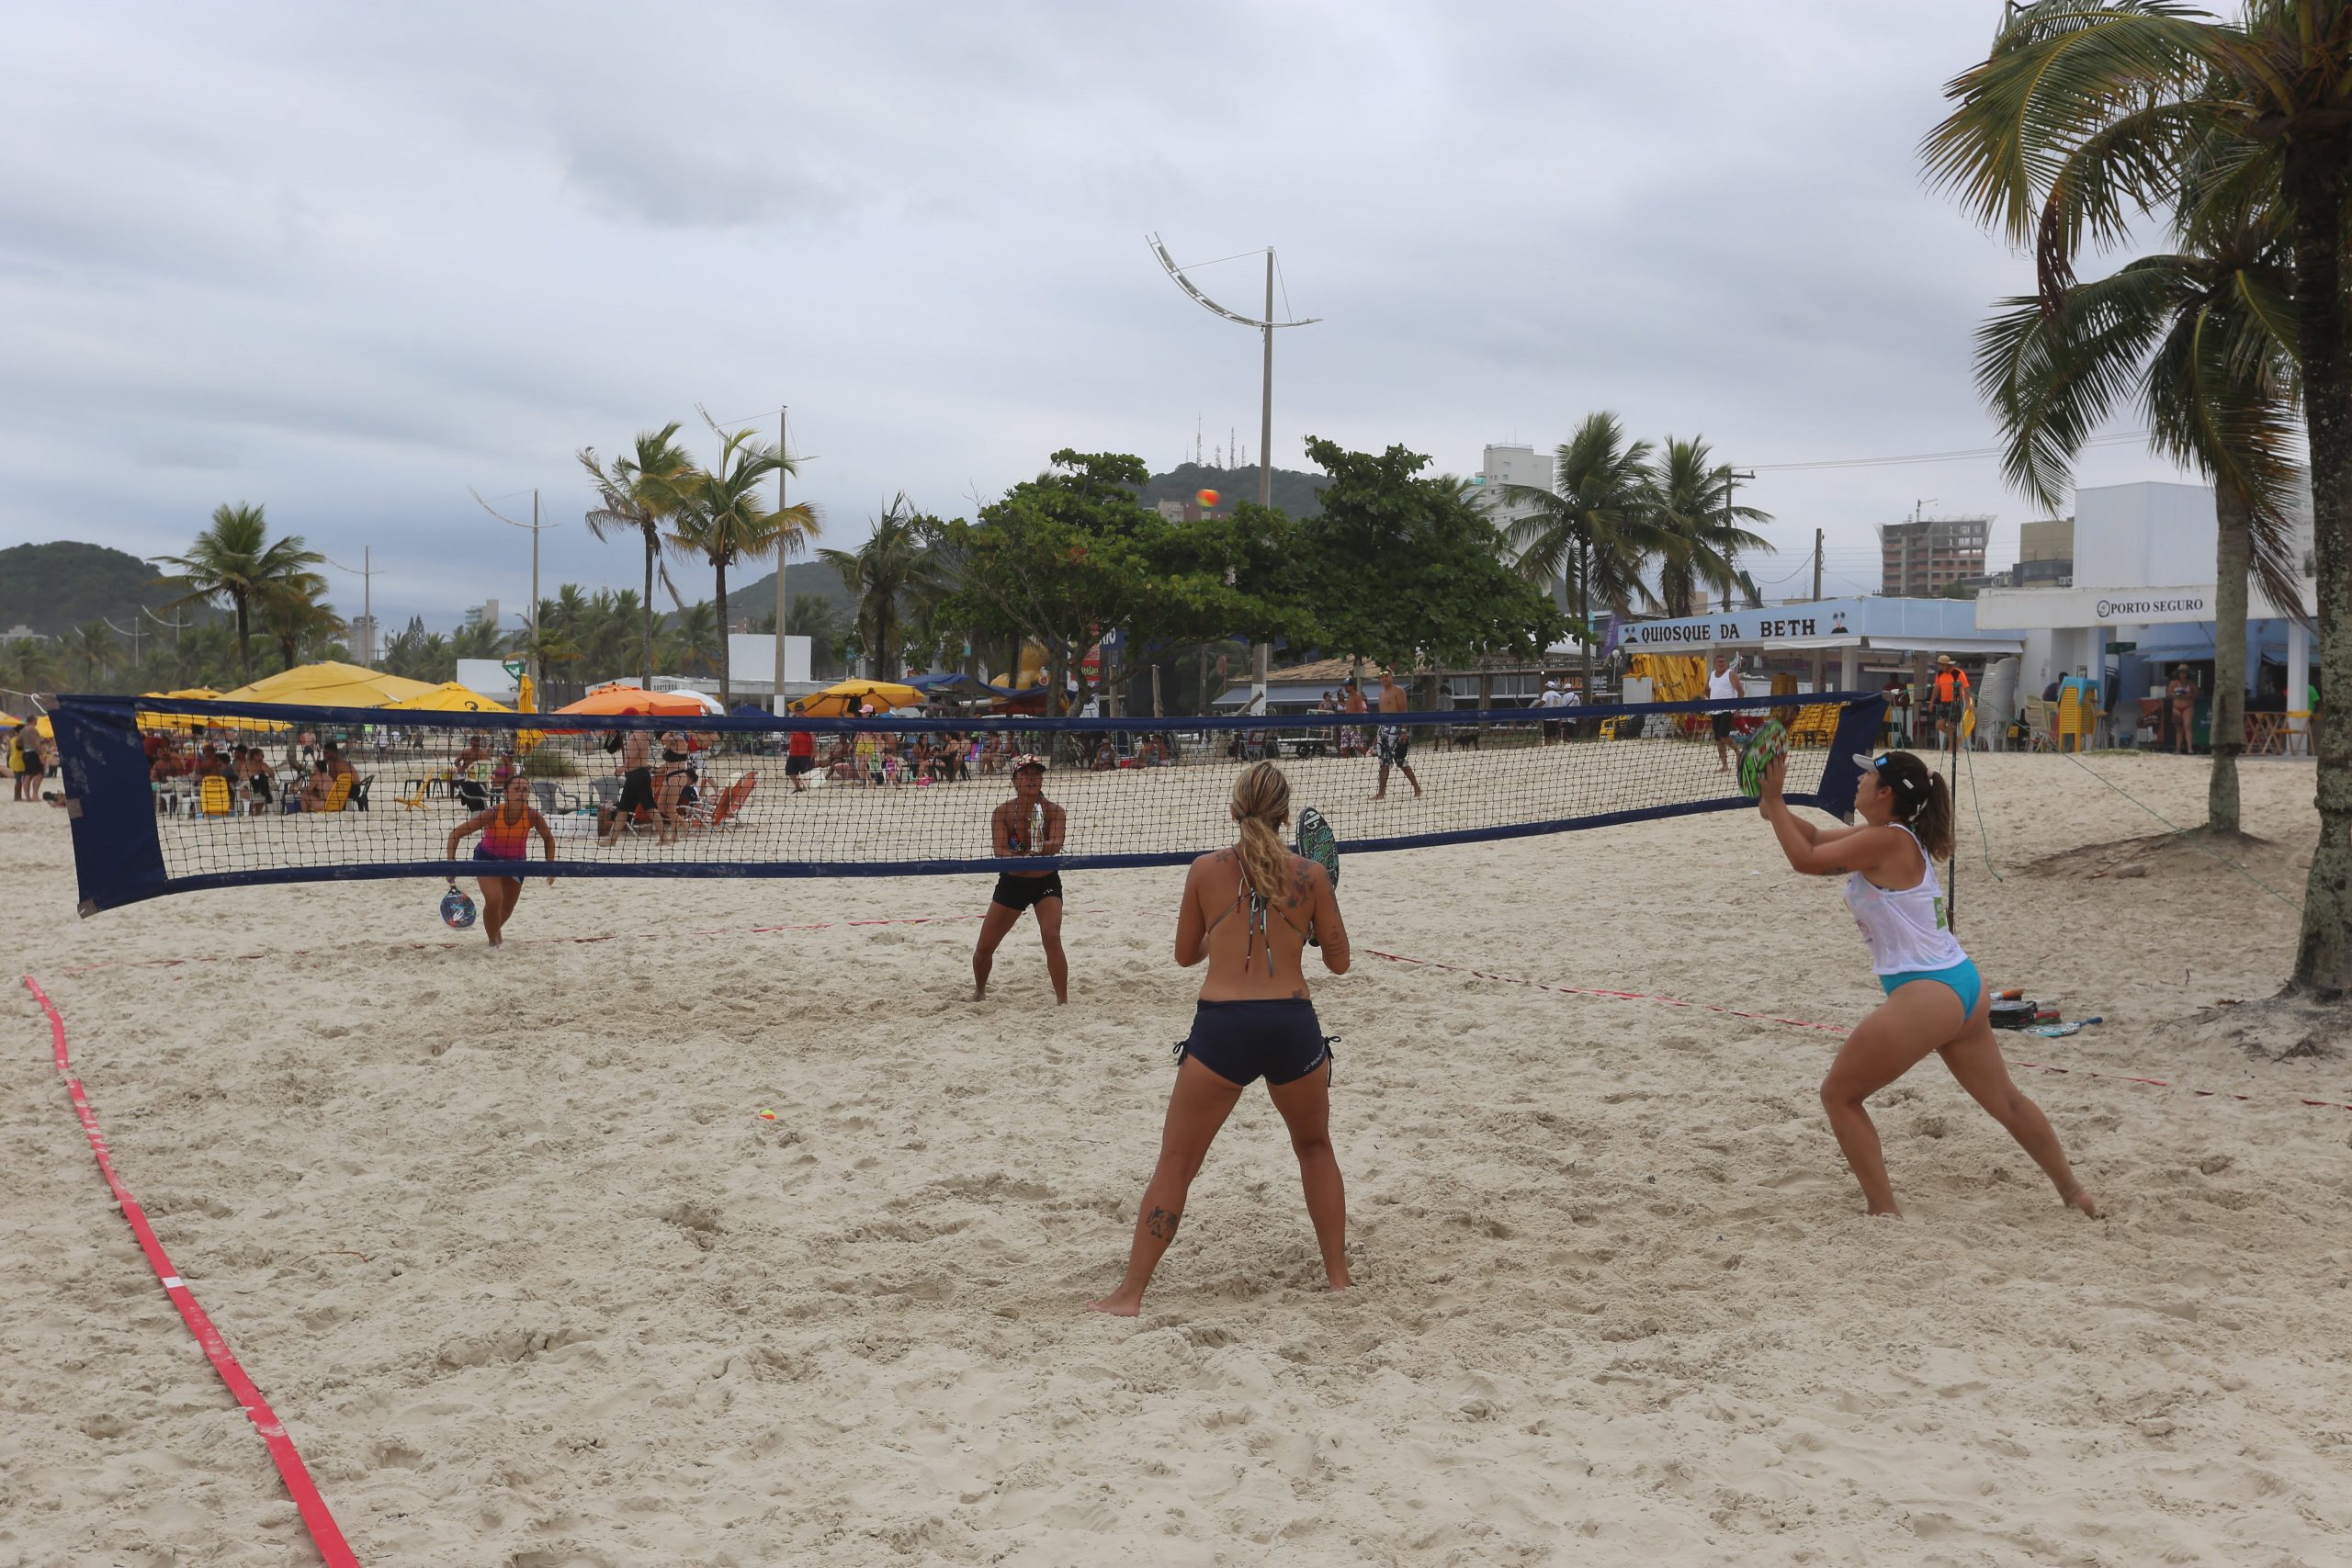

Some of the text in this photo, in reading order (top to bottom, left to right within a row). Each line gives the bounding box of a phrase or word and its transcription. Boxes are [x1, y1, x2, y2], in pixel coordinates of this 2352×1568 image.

[2110, 599, 2203, 614] PORTO SEGURO
[1641, 619, 1815, 643] QUIOSQUE DA BETH
